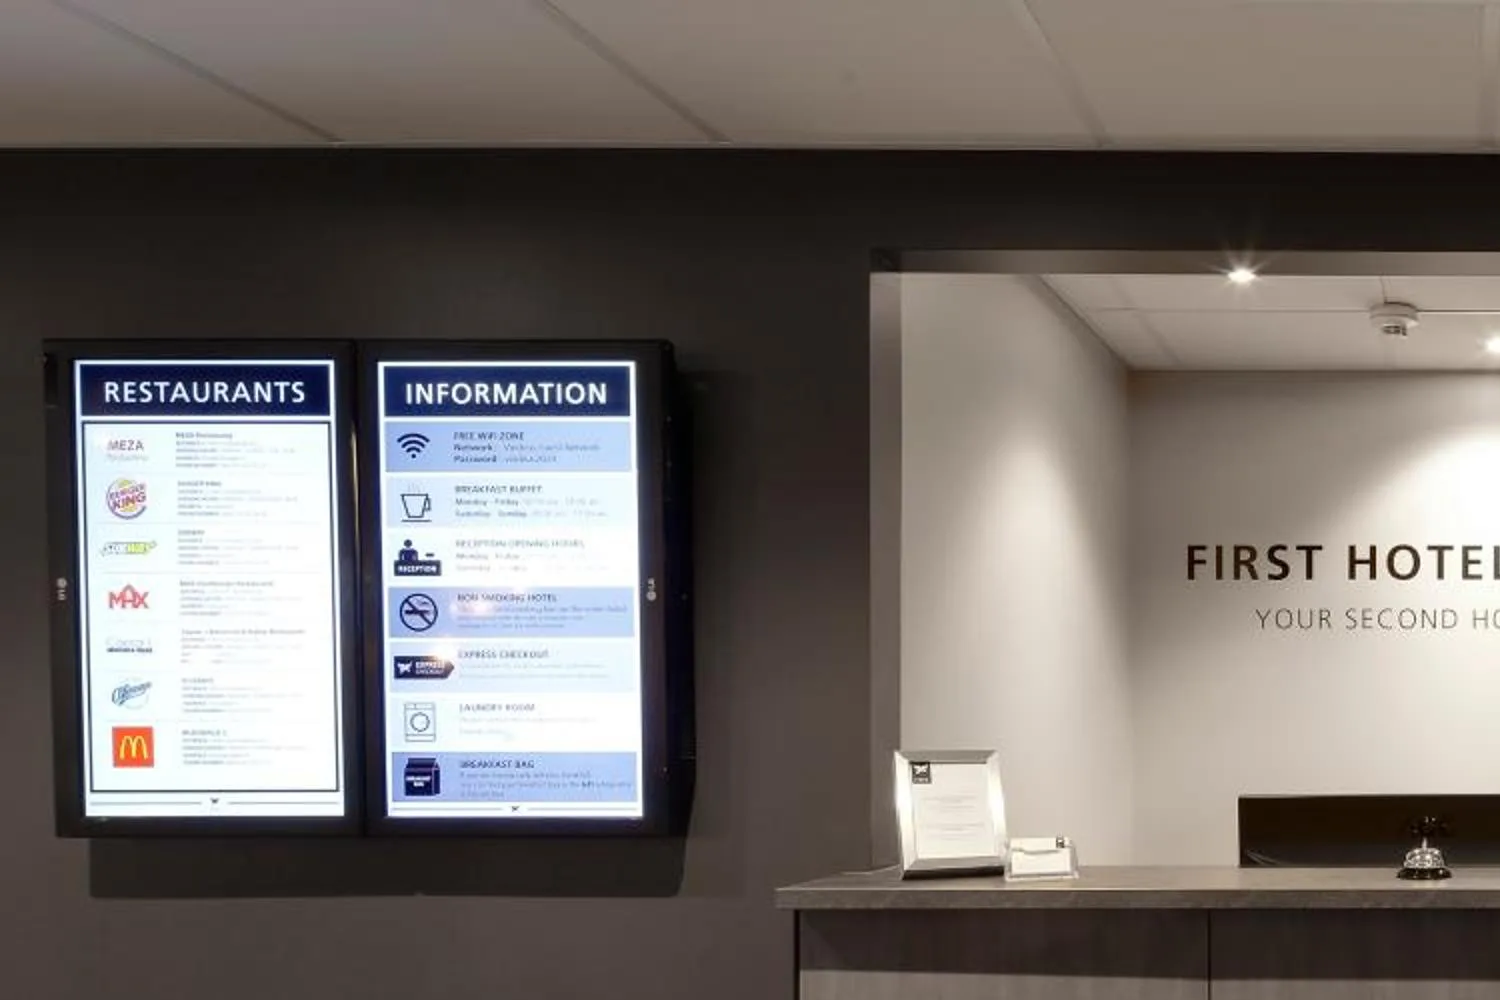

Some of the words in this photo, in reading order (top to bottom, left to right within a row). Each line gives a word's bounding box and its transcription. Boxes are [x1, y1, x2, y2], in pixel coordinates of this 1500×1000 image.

[104, 381, 305, 403] RESTAURANTS
[405, 382, 608, 405] INFORMATION
[107, 439, 145, 451] MEZA
[500, 432, 524, 441] ZONE
[397, 564, 438, 573] RECEPTION
[1186, 545, 1323, 581] FIRST
[108, 584, 150, 609] MAX
[1255, 608, 1333, 631] YOUR
[1344, 608, 1458, 631] SECOND
